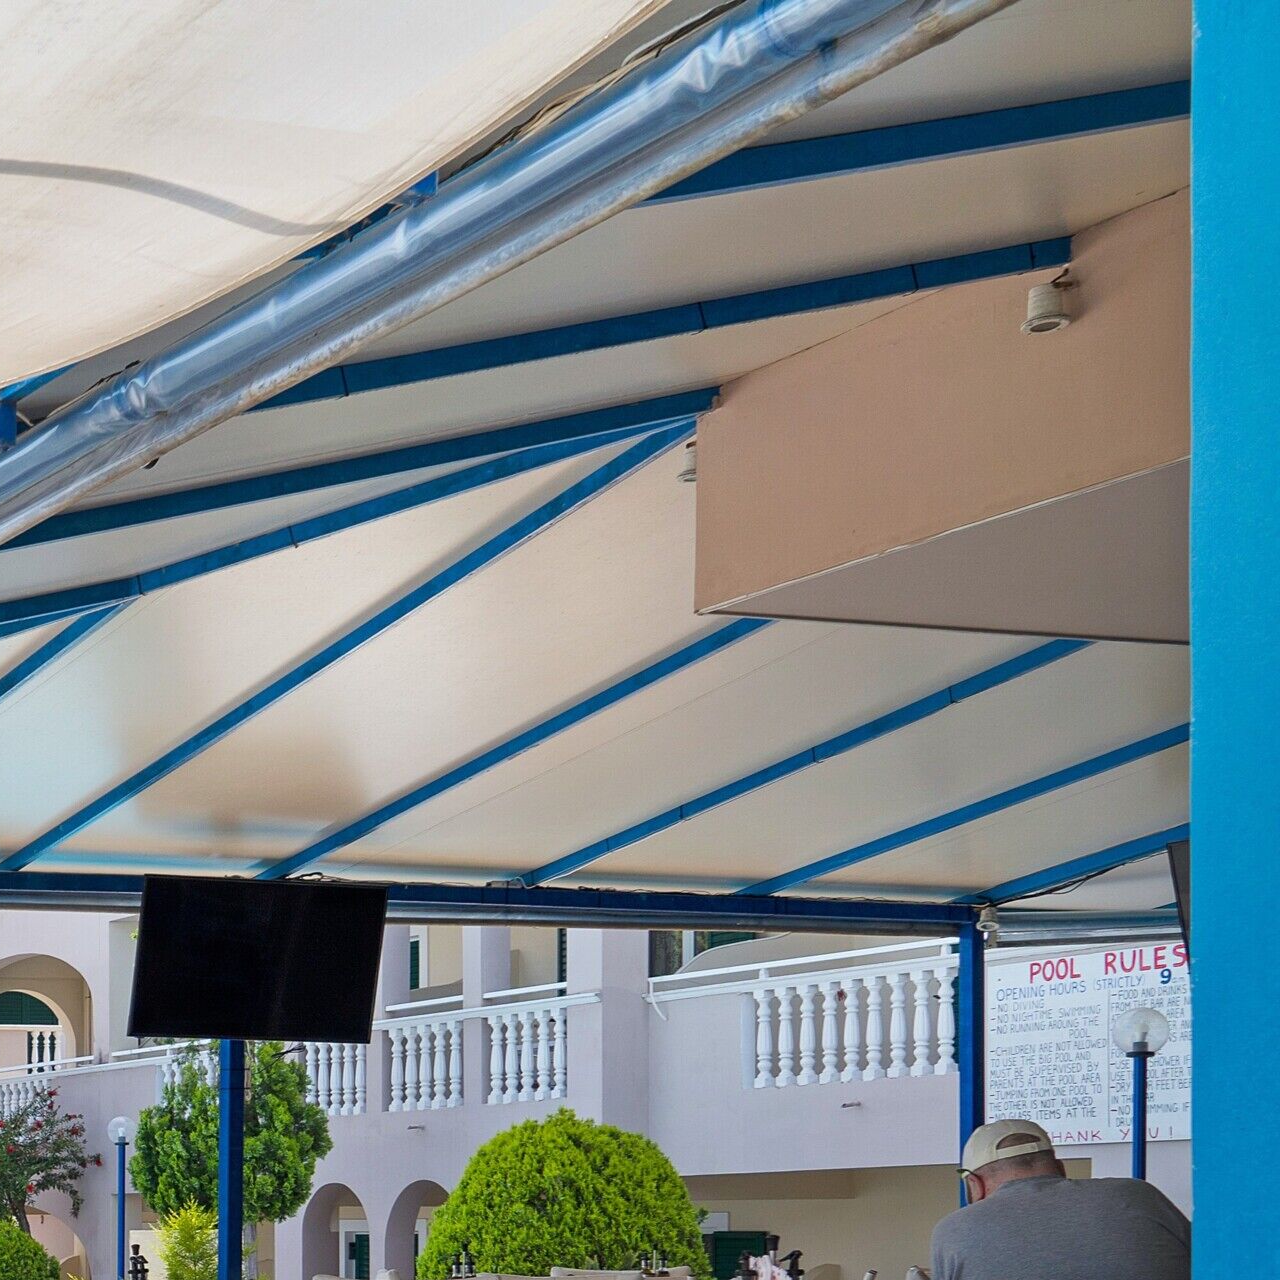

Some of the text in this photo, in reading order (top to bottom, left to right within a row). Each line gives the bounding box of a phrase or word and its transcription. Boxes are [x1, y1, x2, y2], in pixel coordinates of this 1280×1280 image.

[1029, 943, 1188, 984] POOL RULES
[996, 984, 1045, 1002] OPENING
[1049, 980, 1087, 996] HOURS
[1160, 968, 1172, 985] 9
[1141, 987, 1156, 998] AND
[1157, 984, 1187, 996] DRINKS
[1012, 999, 1044, 1012] DIVING
[1111, 1001, 1131, 1012] FROM
[1150, 998, 1164, 1009] BAR
[1166, 996, 1180, 1006] ARE
[1059, 1005, 1101, 1019] SWIMMING
[1166, 1007, 1184, 1018] AREA
[1010, 1022, 1045, 1034] RUNNING
[1082, 1016, 1099, 1027] THE
[1069, 1028, 1091, 1039] POOL
[1040, 1042, 1053, 1053] ARE
[1055, 1041, 1072, 1052] NOT
[1074, 1039, 1107, 1050] ALLOWED
[990, 1051, 1091, 1068] TO USE THE BIG POOL AND
[1149, 1055, 1179, 1067] SHOWER
[990, 1061, 1099, 1079] MUST BE SUPERVISED BY
[1111, 1071, 1125, 1082] USE
[1146, 1068, 1159, 1079] OOL
[1161, 1067, 1184, 1078] AFTER
[989, 1072, 1101, 1089] PARENTS AT THE POOL AREA
[1156, 1079, 1176, 1090] FEET
[1030, 1086, 1050, 1098] FROM
[1052, 1086, 1067, 1096] ONE
[1069, 1085, 1088, 1095] POOL
[1092, 1084, 1102, 1094] TO
[989, 1096, 1093, 1112] THE OTHER IS NOT ALLOWED
[1111, 1095, 1119, 1104] IN
[1008, 1110, 1032, 1120] GLASS
[1035, 1109, 1061, 1120] ITEMS
[1065, 1108, 1077, 1119] AT
[1081, 1107, 1097, 1118] THE
[1147, 1102, 1179, 1114] IMMING
[1183, 1102, 1190, 1112] IF
[1115, 1116, 1131, 1128] DRU
[1047, 1130, 1102, 1143] HANK
